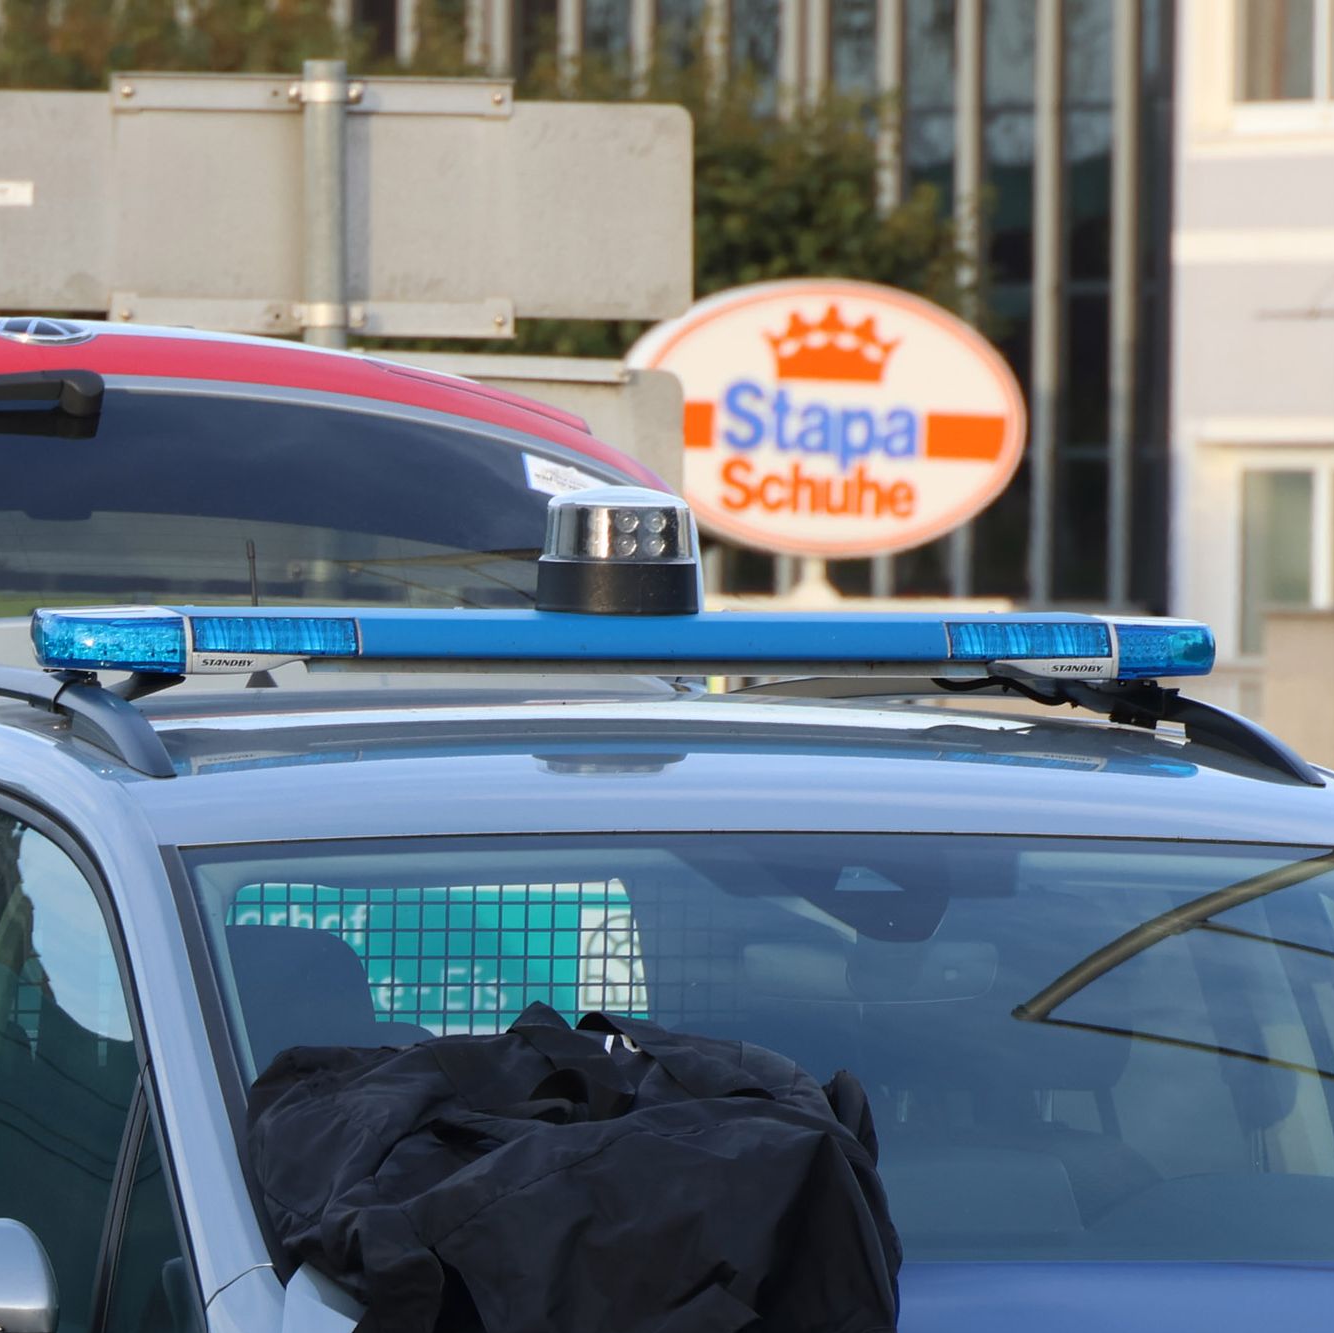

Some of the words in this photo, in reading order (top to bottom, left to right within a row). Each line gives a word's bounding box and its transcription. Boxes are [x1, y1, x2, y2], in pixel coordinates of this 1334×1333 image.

[723, 381, 918, 473] Stapa
[720, 458, 916, 519] Schuhe
[202, 658, 254, 667] STANDBY
[1051, 664, 1104, 673] STANDBY
